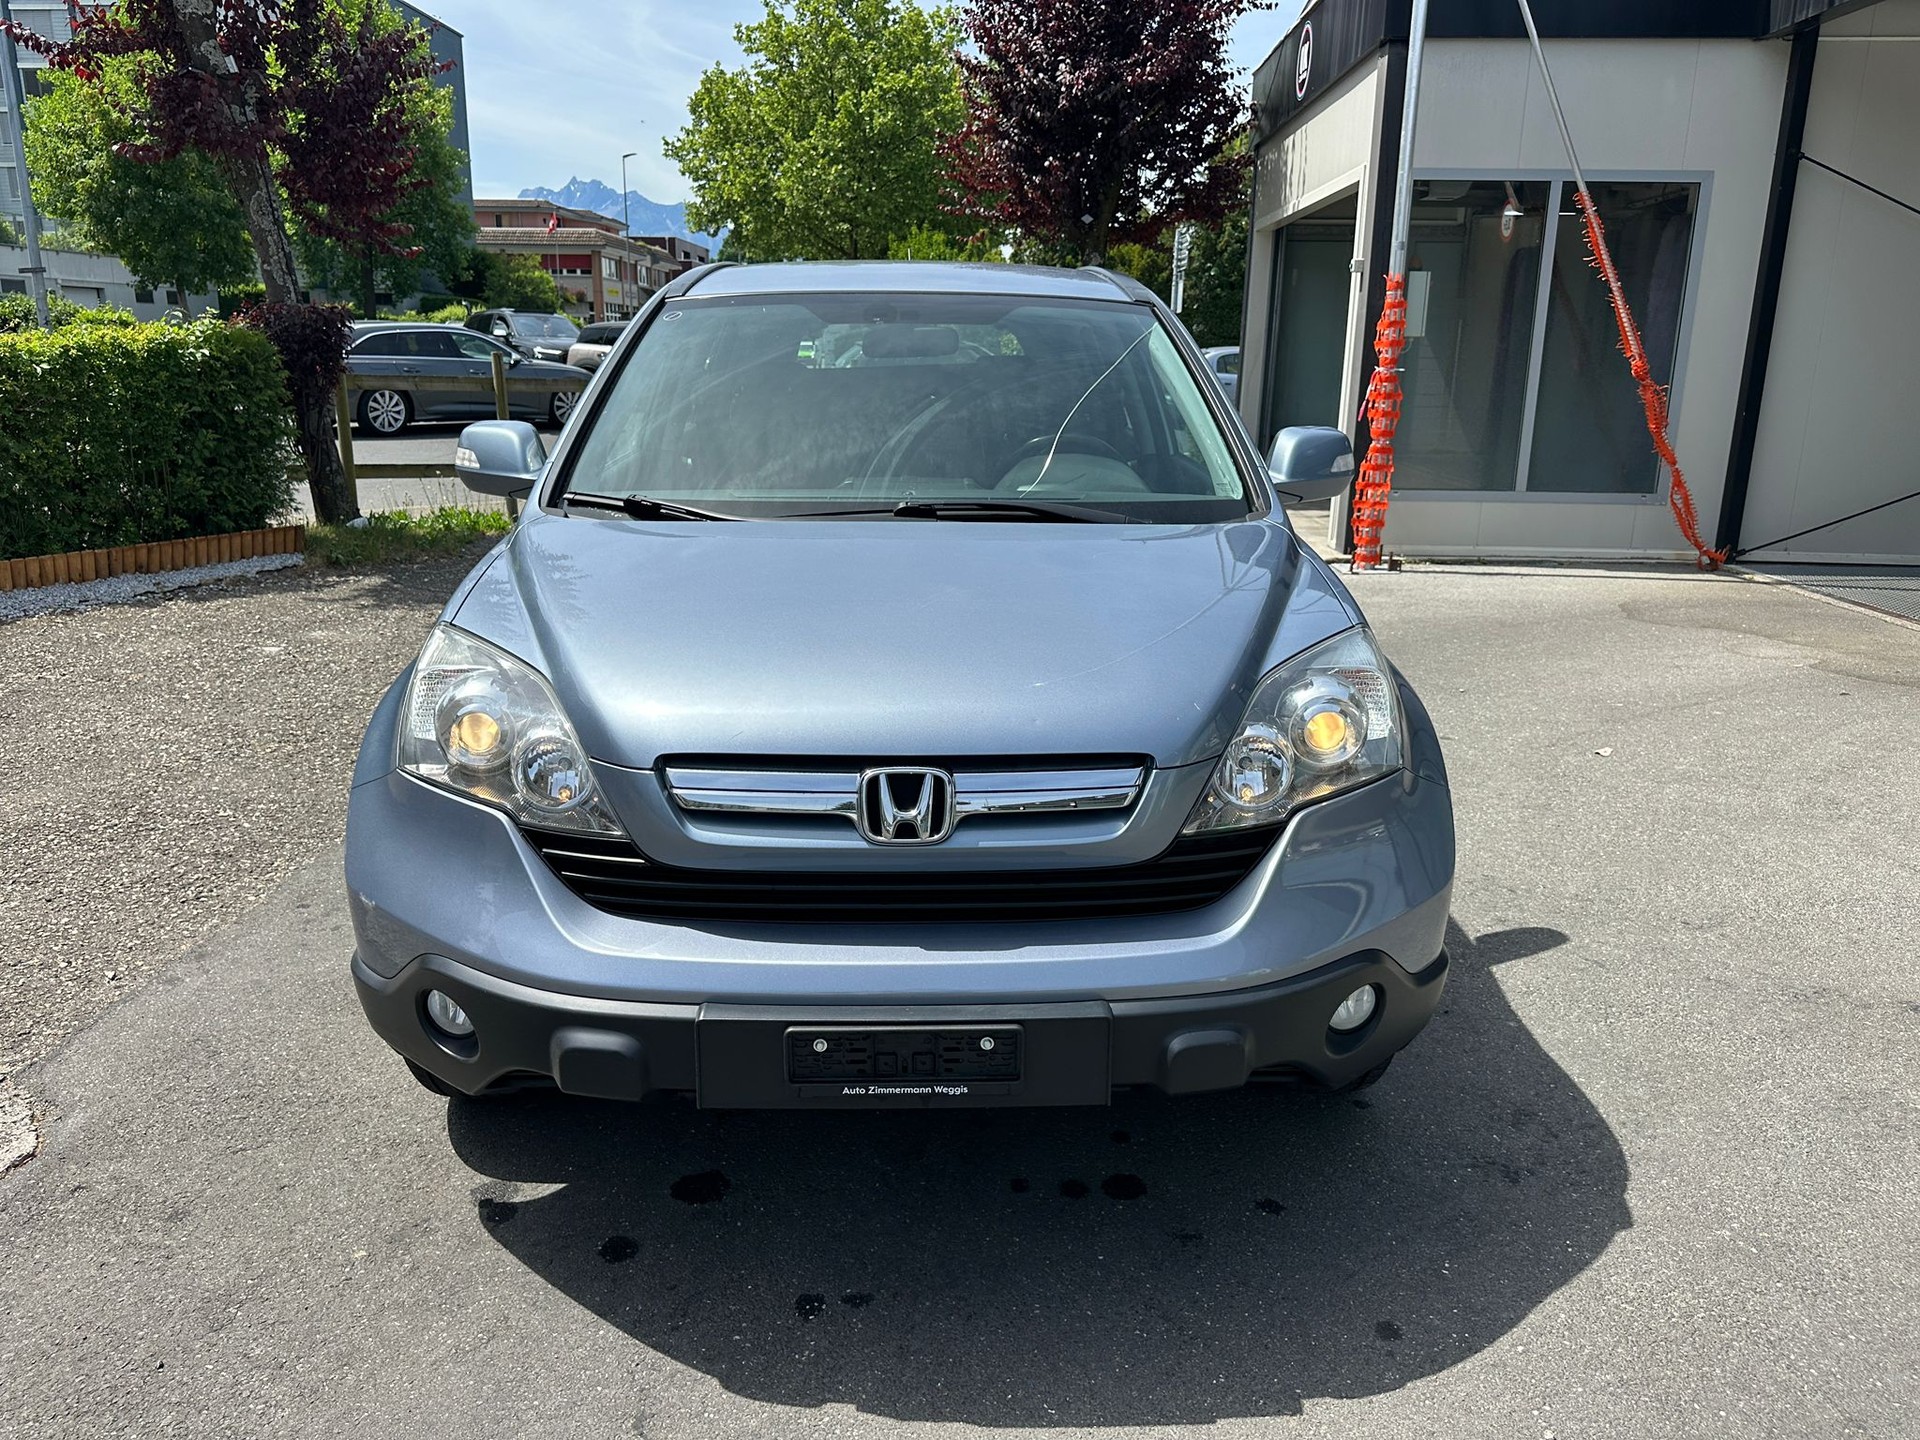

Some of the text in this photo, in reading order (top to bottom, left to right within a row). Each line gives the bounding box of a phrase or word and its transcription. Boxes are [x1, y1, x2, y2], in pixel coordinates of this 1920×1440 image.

[842, 1084, 969, 1096] Auto Zimmermann Weggis
